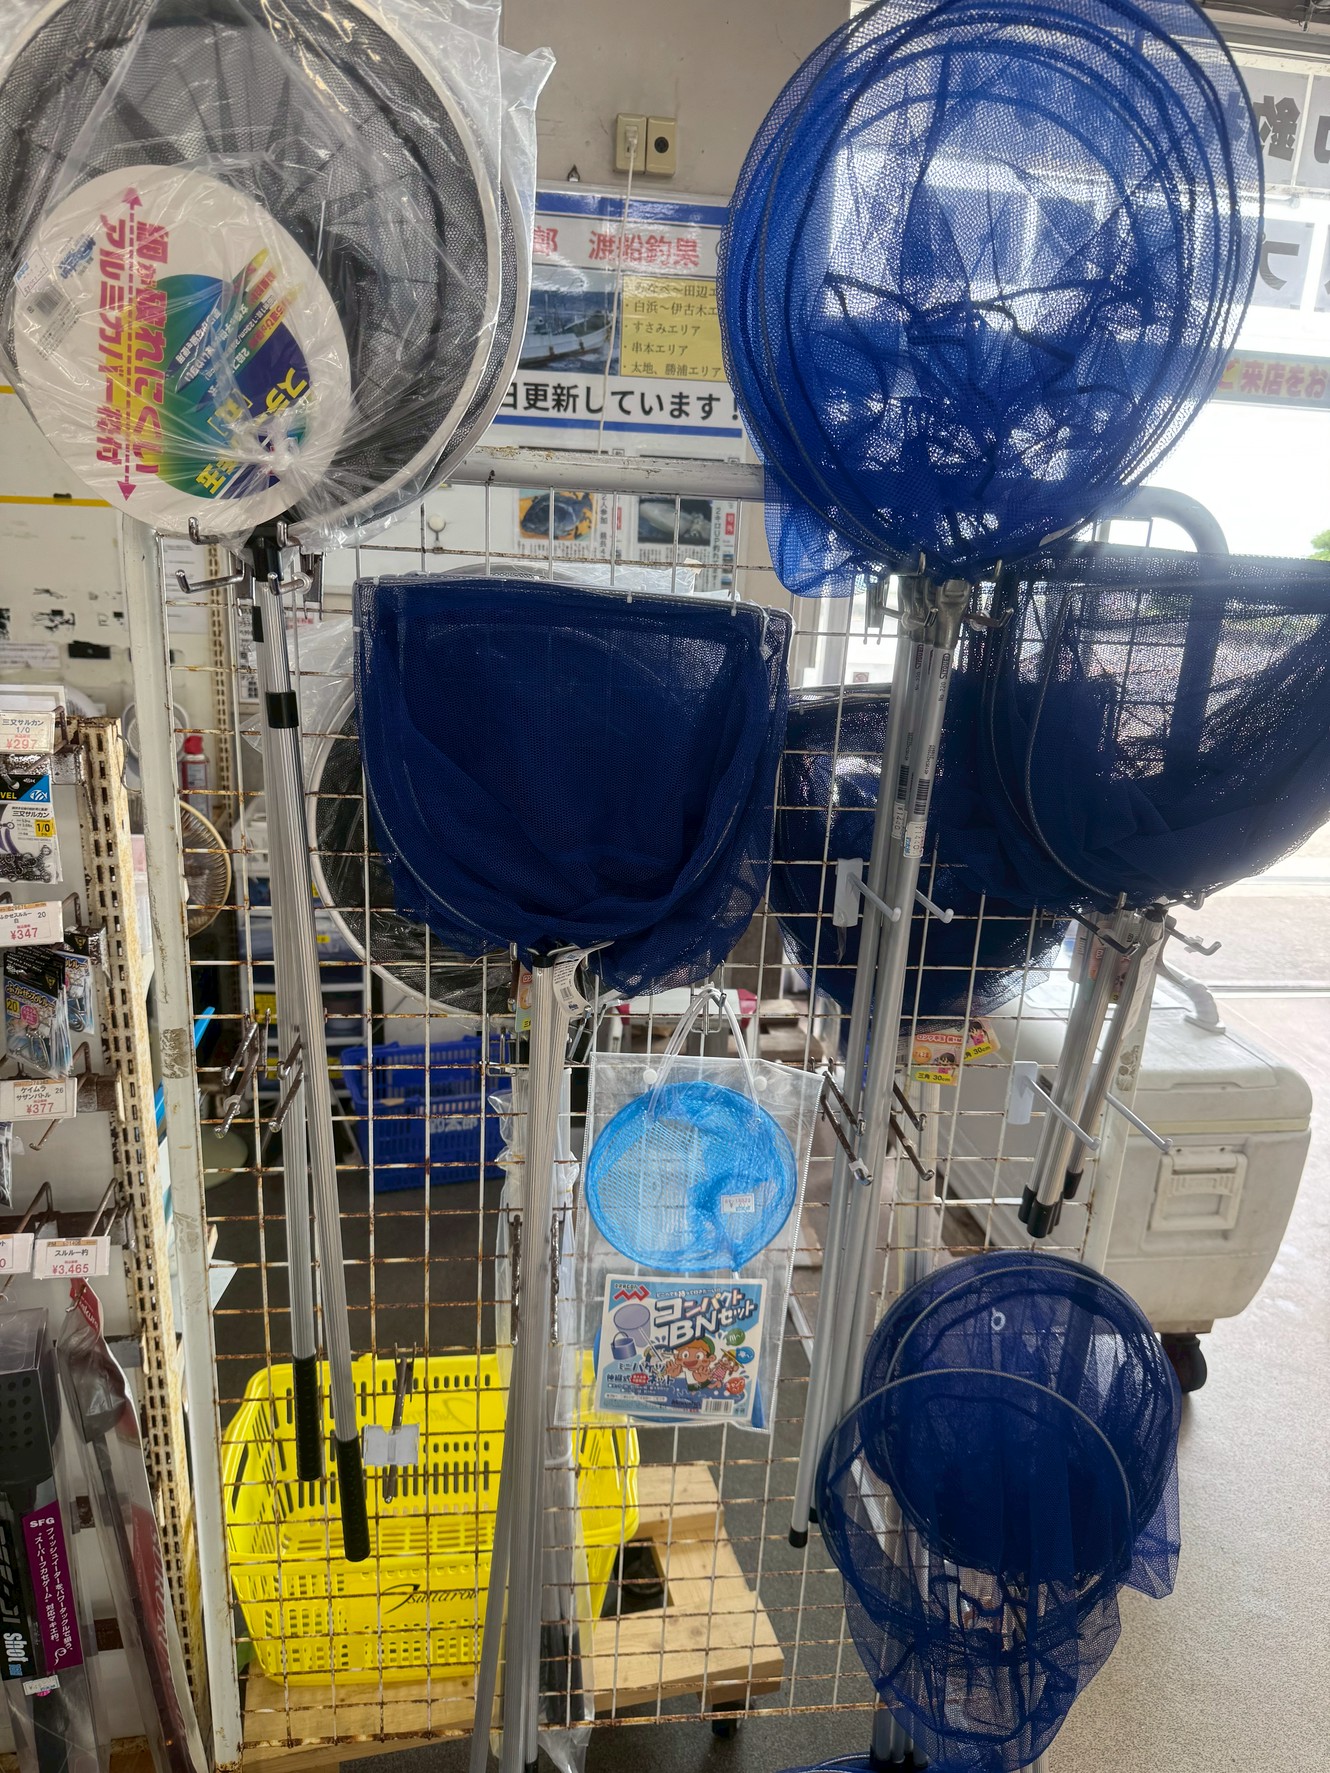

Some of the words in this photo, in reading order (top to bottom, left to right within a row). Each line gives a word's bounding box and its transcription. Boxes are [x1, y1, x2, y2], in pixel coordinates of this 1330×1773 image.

[589, 229, 701, 267] 渡船釣果
[633, 321, 701, 336] すさみエリア
[96, 214, 128, 466] アルミカバー枠付
[133, 221, 169, 475] 網が破れにくい
[632, 342, 688, 356] 串本エリア
[6, 739, 37, 749] ¥297
[36, 823, 50, 832] 1/0
[10, 927, 38, 940] ¥347
[6, 999, 18, 1012] 20
[917, 1072, 931, 1080] 三角
[20, 1086, 47, 1094] ケイムラ
[16, 1093, 51, 1101] サザンバトル
[26, 1102, 54, 1114] ¥377
[55, 1249, 89, 1257] スルルー杓
[52, 1264, 89, 1274] ¥3,465
[655, 1288, 745, 1328] コンパクト
[29, 1517, 55, 1528] SFG
[3, 1632, 29, 1662] shot
